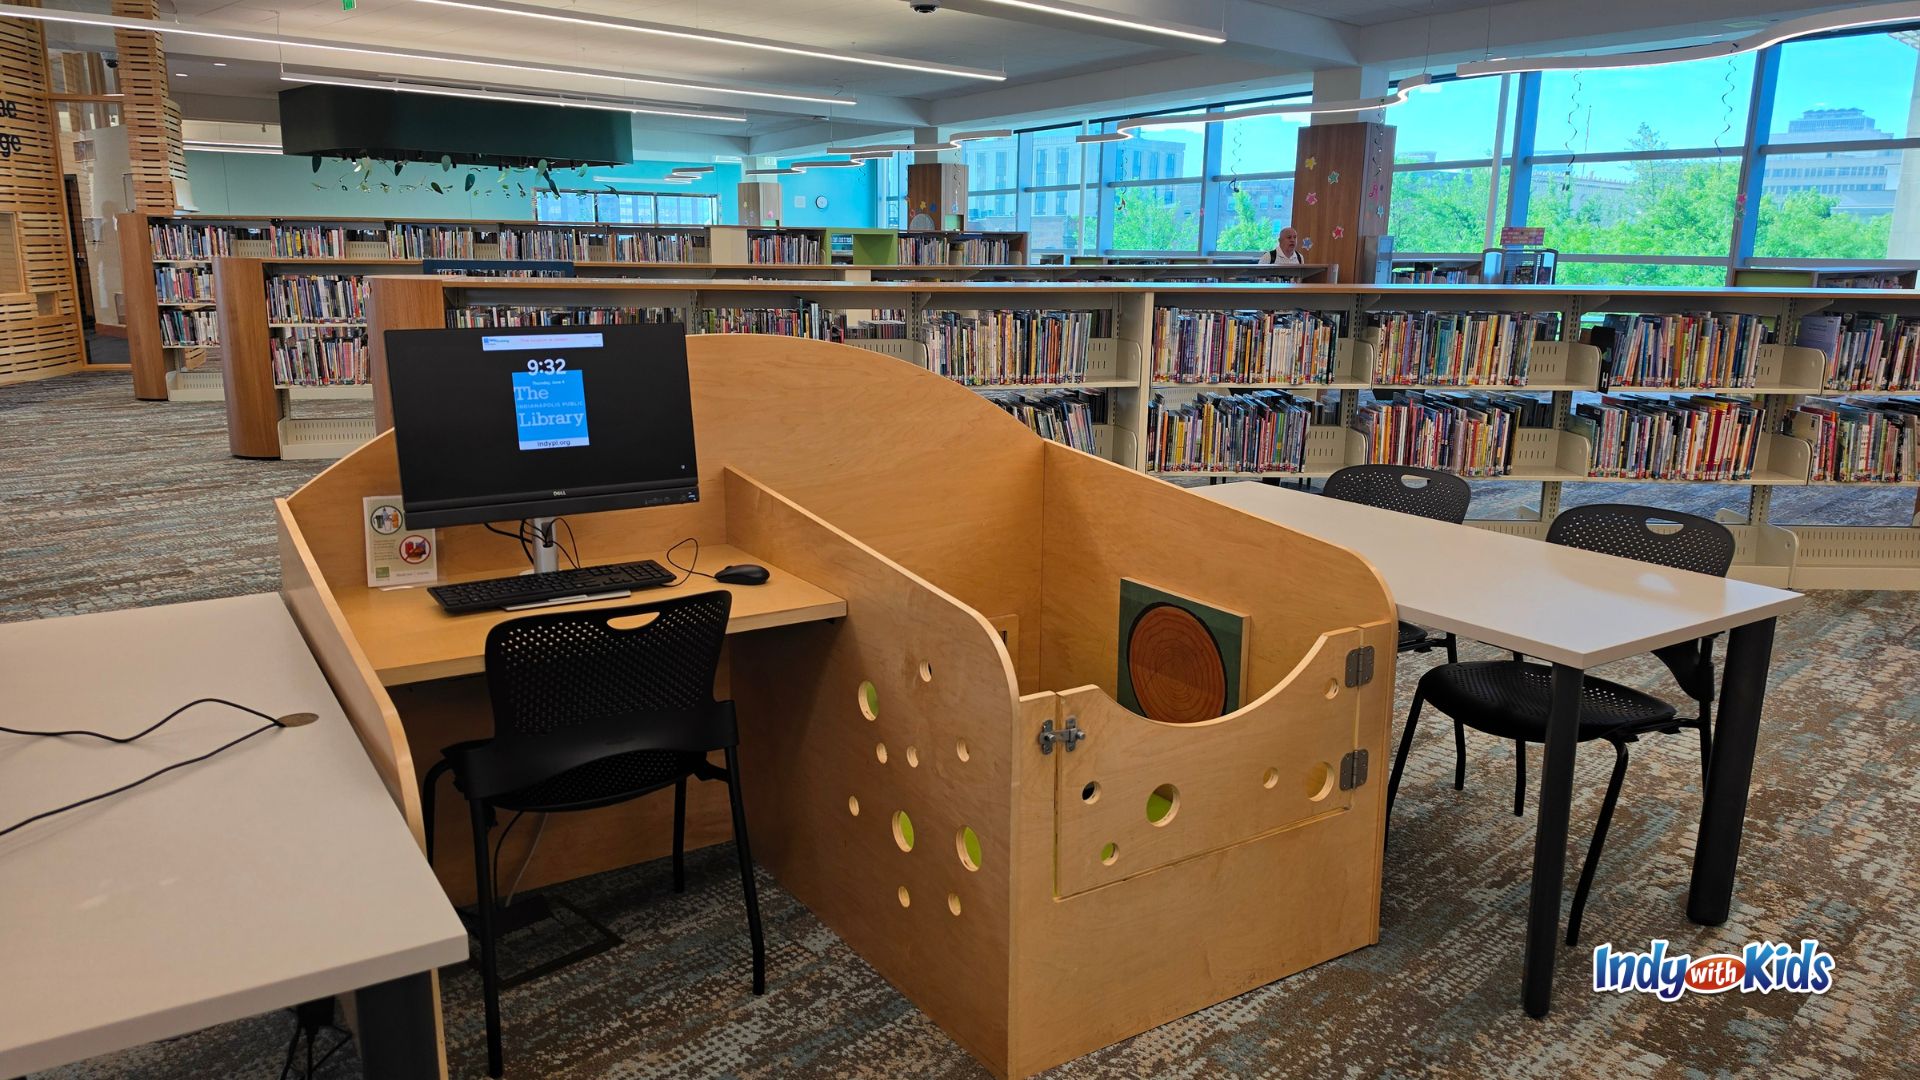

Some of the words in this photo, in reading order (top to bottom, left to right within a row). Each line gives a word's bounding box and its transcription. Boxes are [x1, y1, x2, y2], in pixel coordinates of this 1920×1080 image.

[527, 358, 566, 376] 9:32
[513, 386, 549, 400] The
[518, 411, 585, 427] Library
[537, 439, 571, 447] indypl.org
